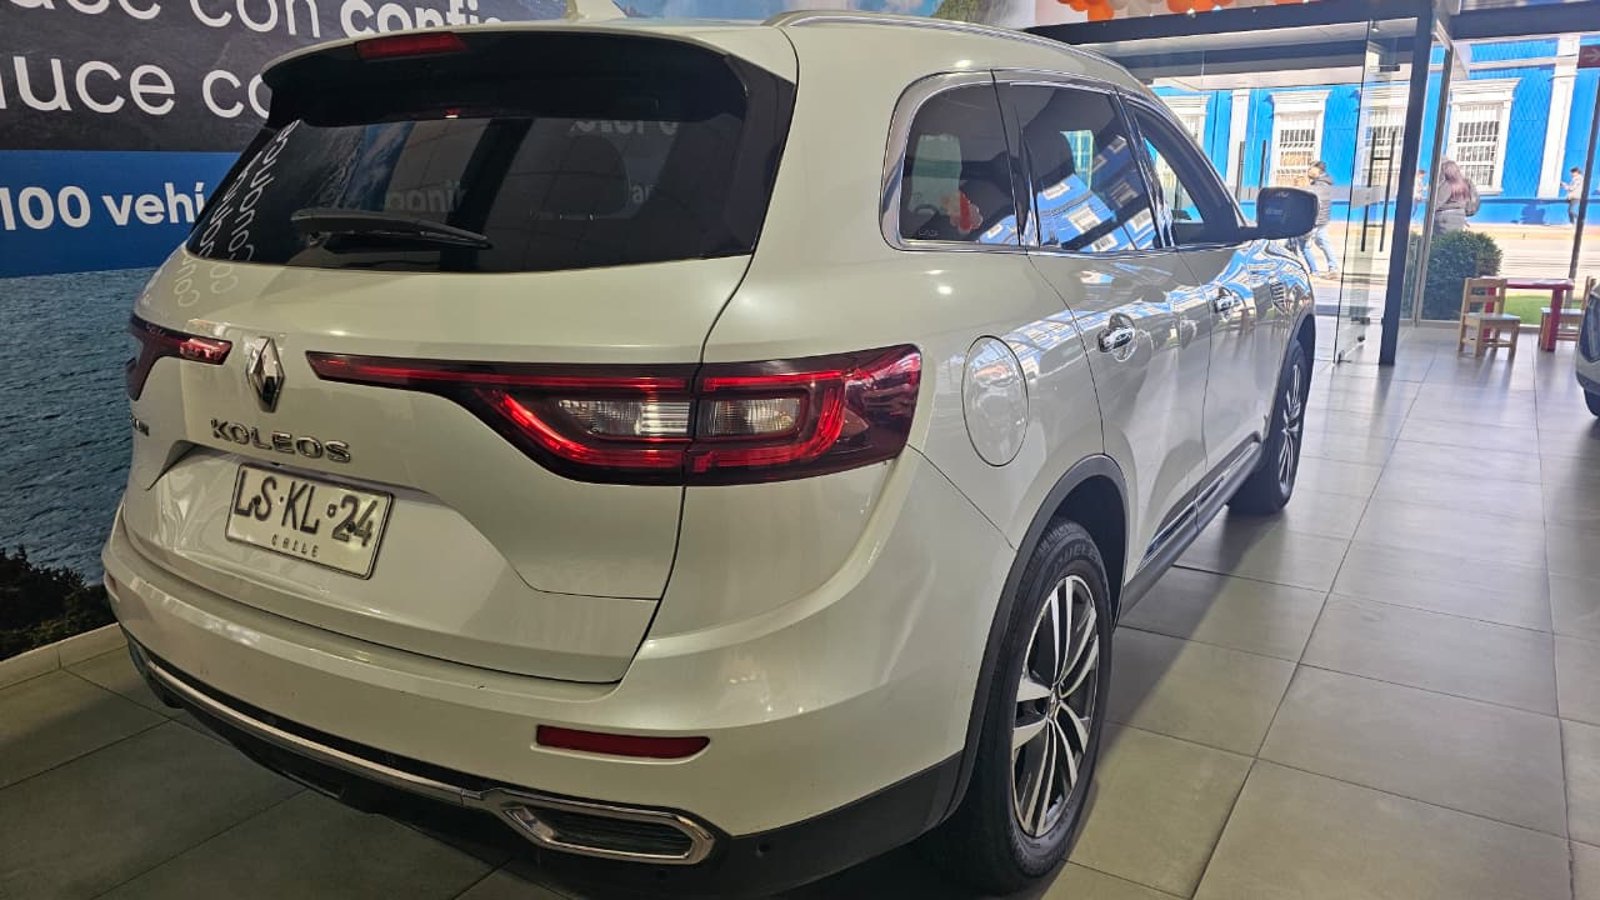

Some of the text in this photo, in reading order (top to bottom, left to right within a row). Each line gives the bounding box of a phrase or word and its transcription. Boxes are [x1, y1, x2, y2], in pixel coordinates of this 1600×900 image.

[0, 56, 176, 116] uce
[210, 418, 351, 463] KOLEOS
[271, 533, 320, 558] CHILE
